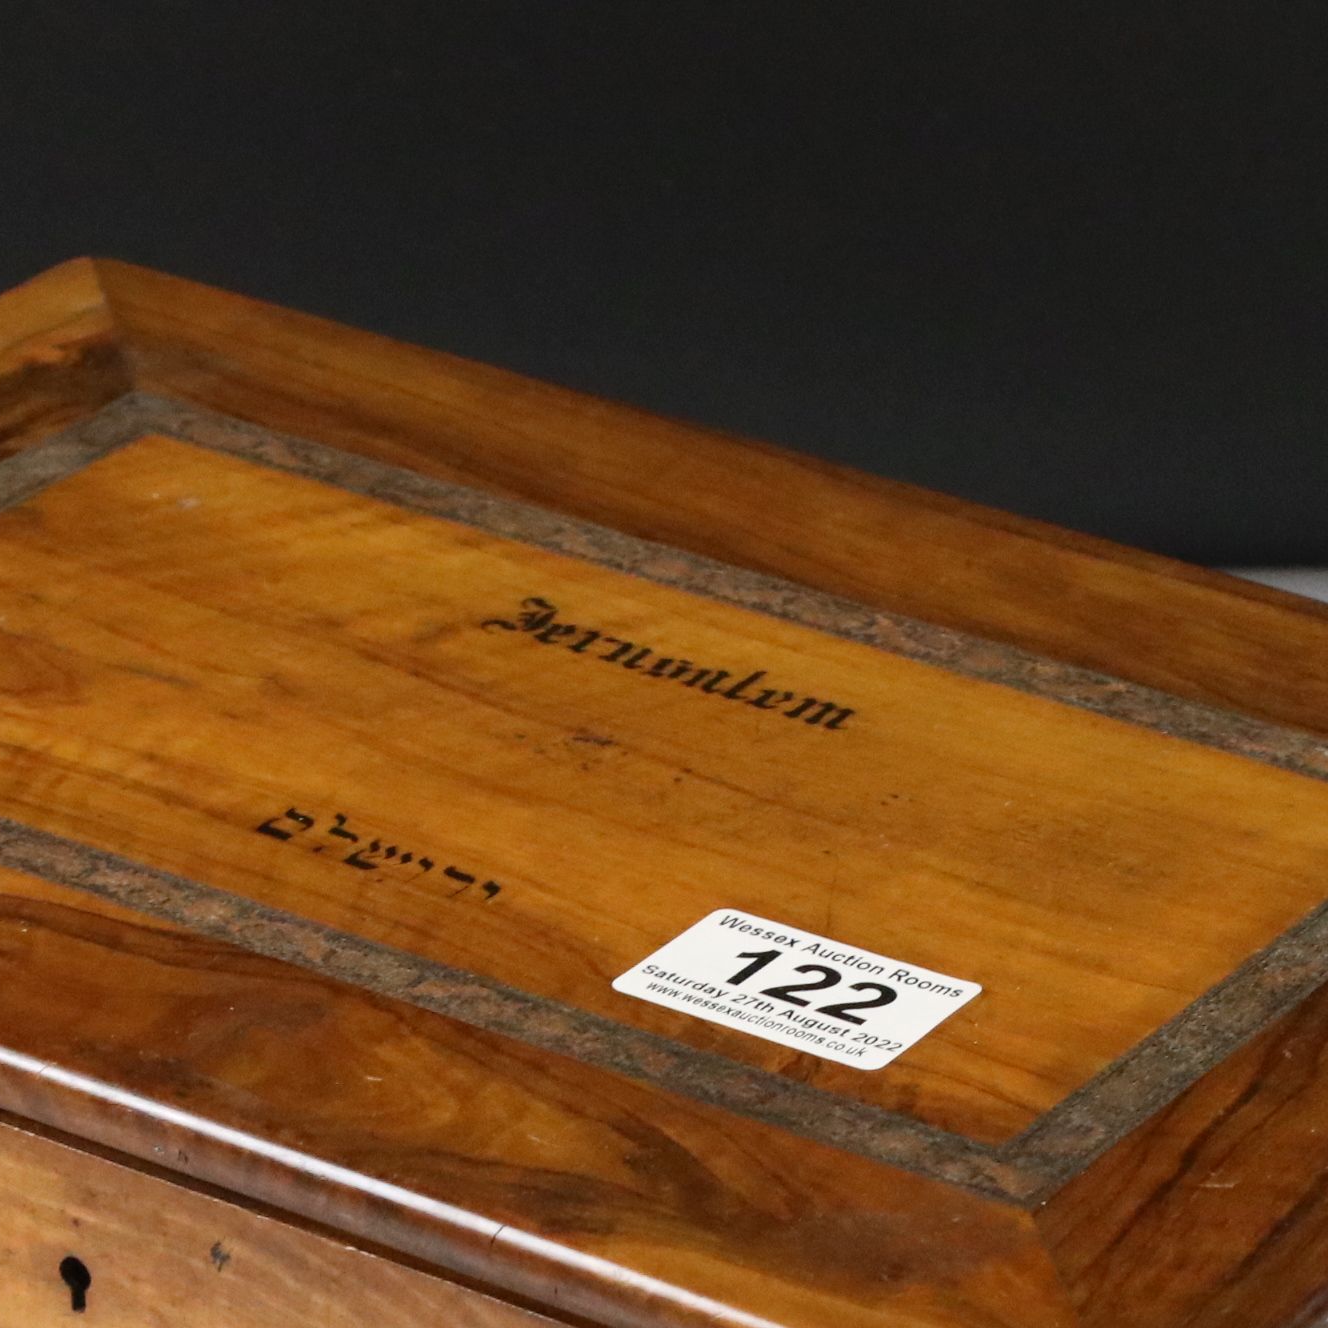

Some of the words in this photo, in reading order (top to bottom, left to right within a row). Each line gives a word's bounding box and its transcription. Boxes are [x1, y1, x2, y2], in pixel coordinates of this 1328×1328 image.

[719, 914, 799, 949] Wessex
[802, 943, 887, 978] Auction
[888, 968, 964, 999] Rooms
[726, 949, 899, 1026] 122
[642, 964, 729, 998] Saturday
[732, 993, 774, 1013] 27th
[779, 1007, 850, 1037] August
[852, 1032, 904, 1053] 2022
[646, 981, 866, 1058] www.wessexauctionrooms.co.uk
